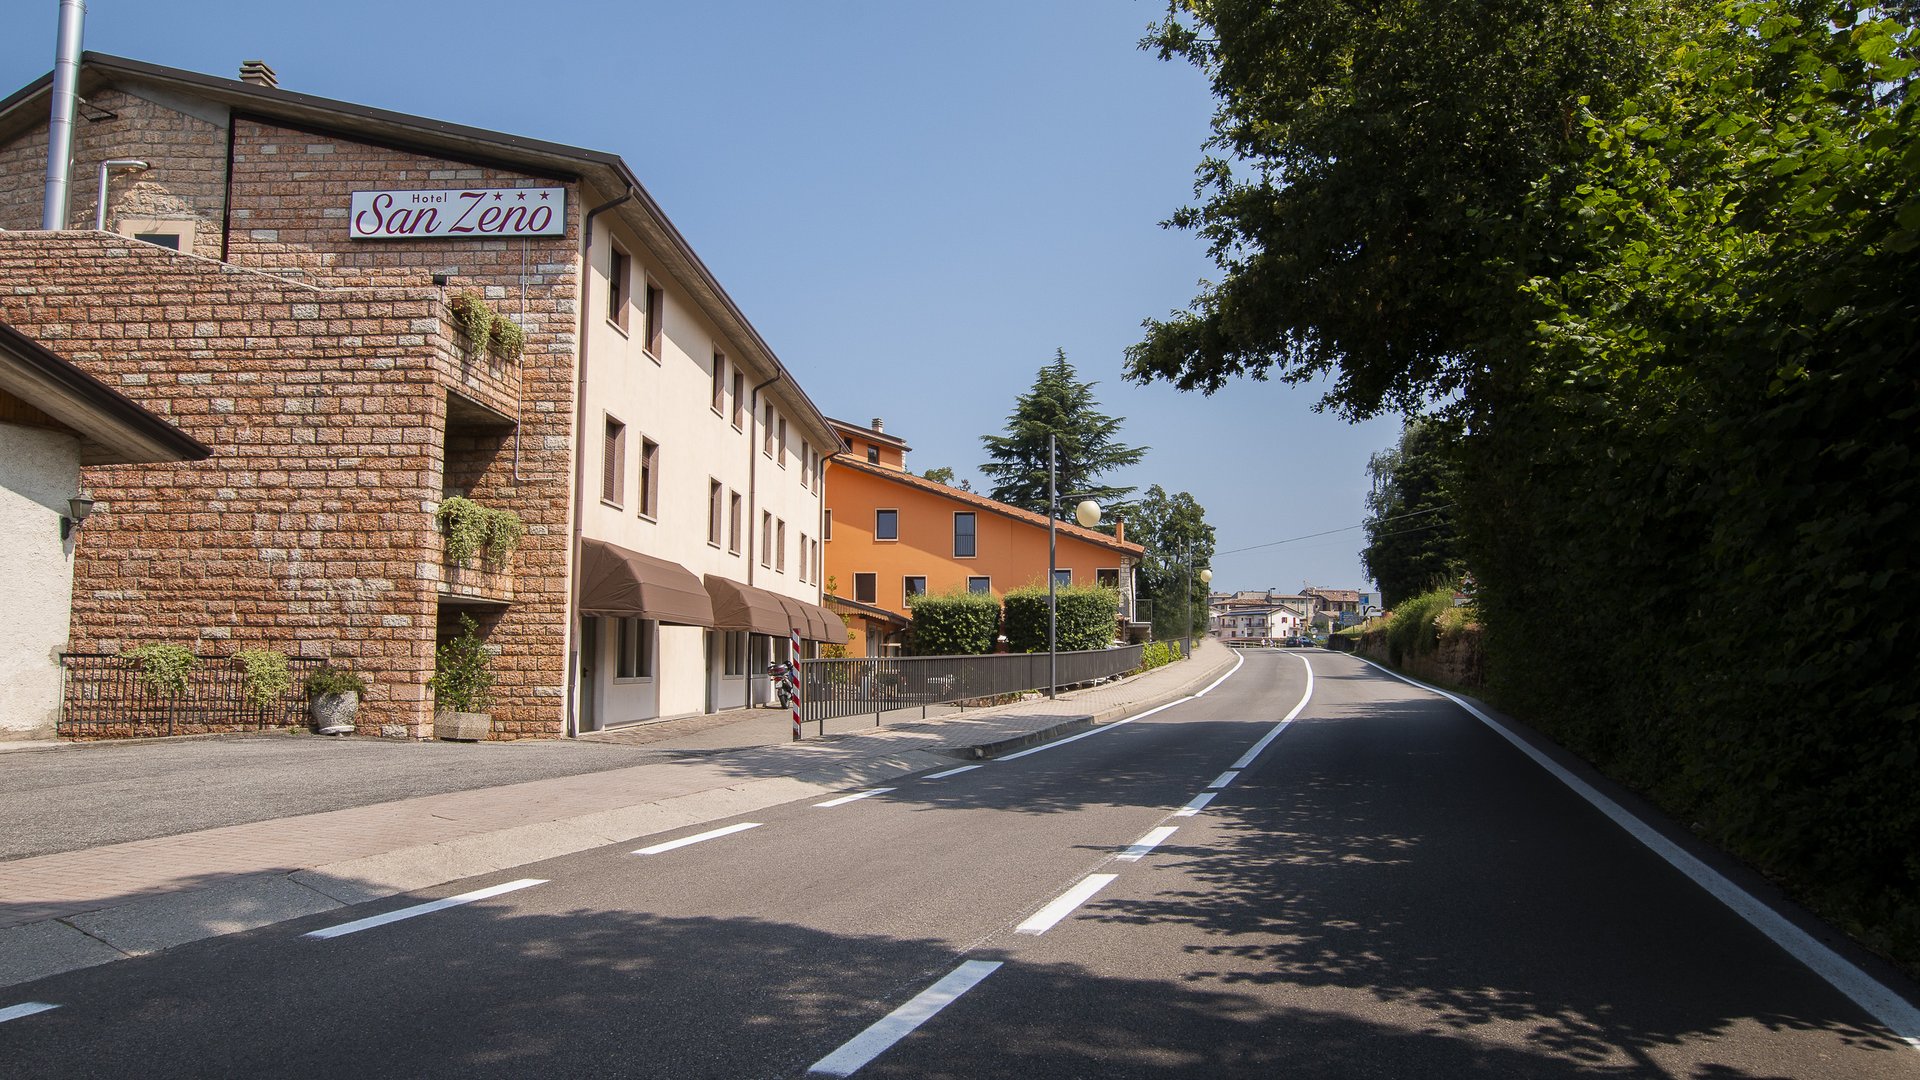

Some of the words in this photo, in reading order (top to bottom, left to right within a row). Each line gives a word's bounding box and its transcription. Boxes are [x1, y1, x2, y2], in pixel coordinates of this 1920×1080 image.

[412, 192, 447, 203] Hotel
[355, 193, 442, 235] San
[448, 191, 553, 233] Zeno
